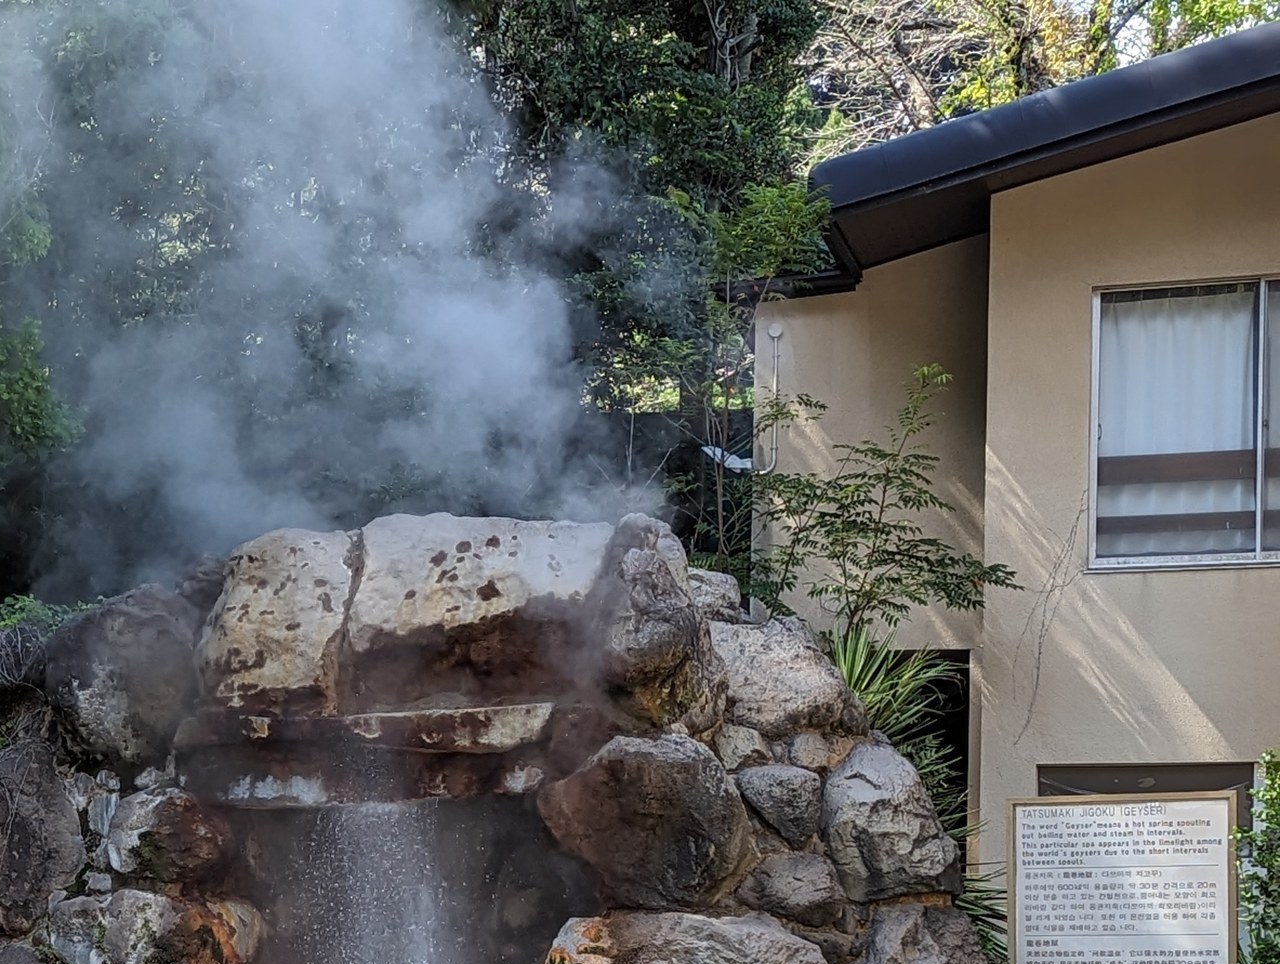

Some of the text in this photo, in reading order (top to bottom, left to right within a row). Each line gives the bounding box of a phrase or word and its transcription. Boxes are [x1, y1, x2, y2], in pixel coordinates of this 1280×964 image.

[1021, 805, 1167, 819] TATSUMAKI JIGOKU (GEYSER)
[1039, 822, 1058, 830] word
[1132, 820, 1145, 828] hot
[1148, 820, 1174, 829] spring
[1176, 819, 1212, 828] spouting
[1067, 831, 1090, 839] water
[1093, 830, 1107, 838] and
[1110, 830, 1134, 838] steam
[1146, 828, 1186, 837] intervals.
[1040, 841, 1079, 850] particular
[1098, 840, 1130, 849] appears
[1143, 838, 1156, 846] the
[1158, 838, 1194, 847] limelight
[1196, 838, 1223, 847] among
[1021, 850, 1035, 858] the
[1104, 848, 1118, 856] due
[1132, 847, 1146, 856] the
[1148, 847, 1170, 855] short
[1172, 846, 1209, 854] intervals
[1021, 859, 1056, 867] between
